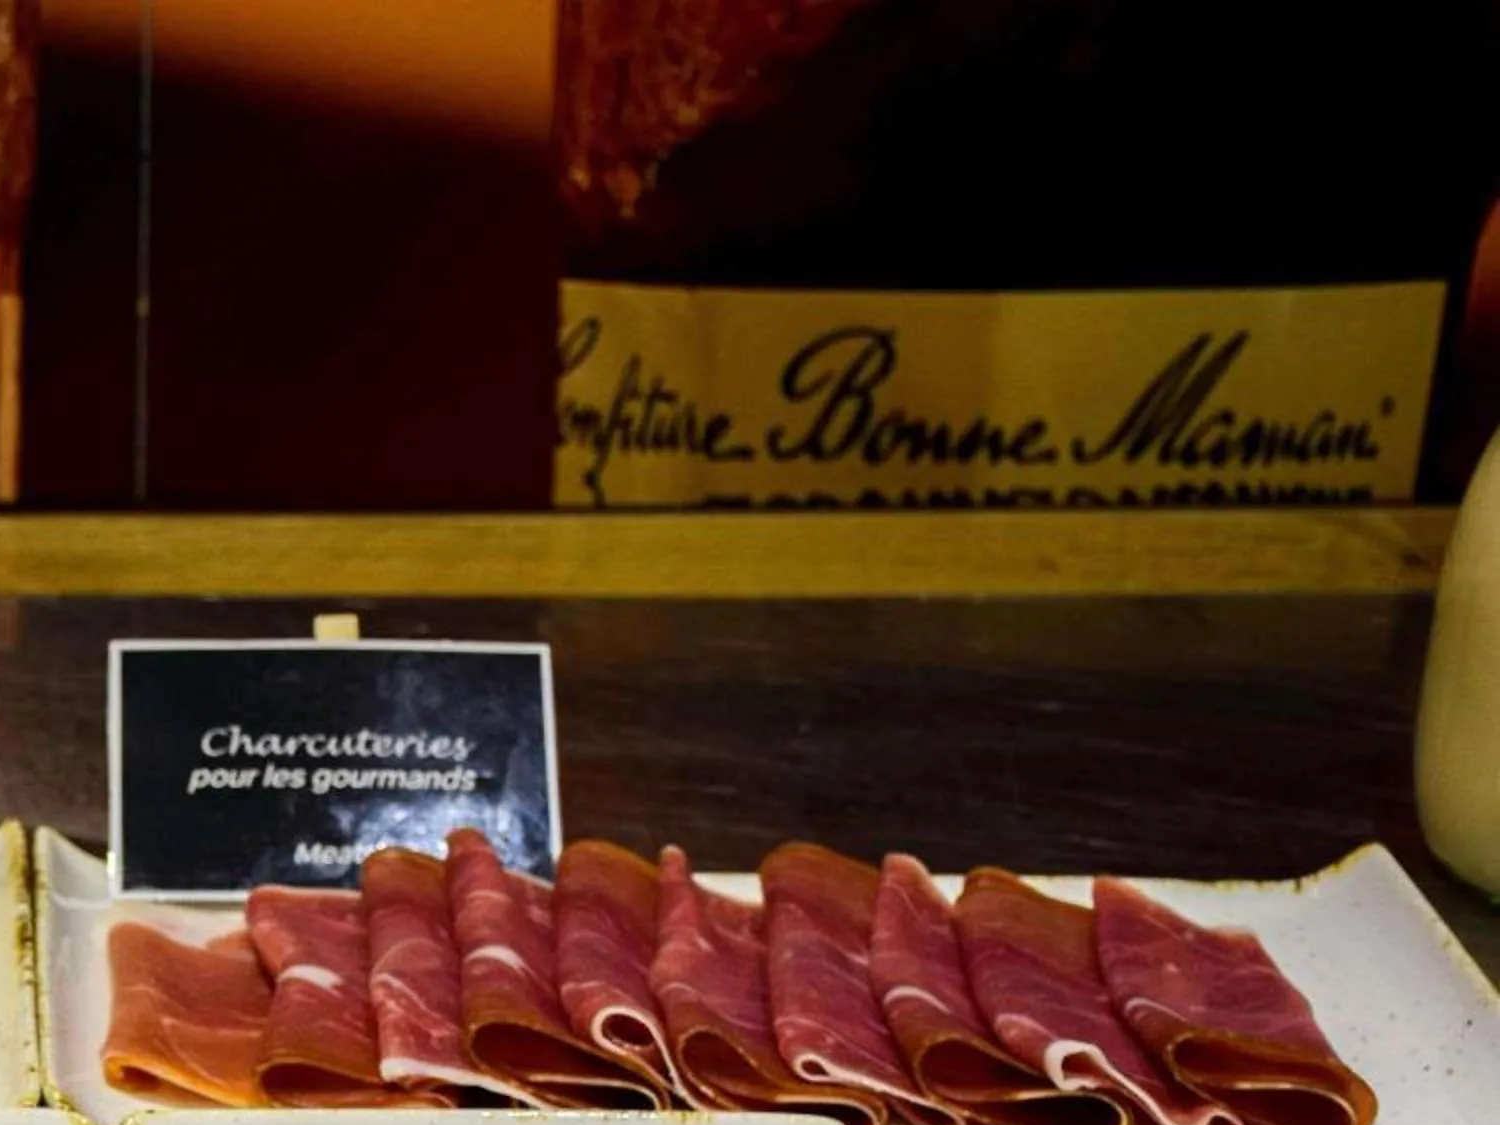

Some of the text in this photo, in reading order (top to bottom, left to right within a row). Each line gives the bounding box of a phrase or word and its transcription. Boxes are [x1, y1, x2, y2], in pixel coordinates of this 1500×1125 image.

[766, 326, 1057, 463] Bonne
[1072, 330, 1380, 465] Maman
[200, 725, 474, 761] Charcuteries
[187, 763, 477, 795] pour les gourmands
